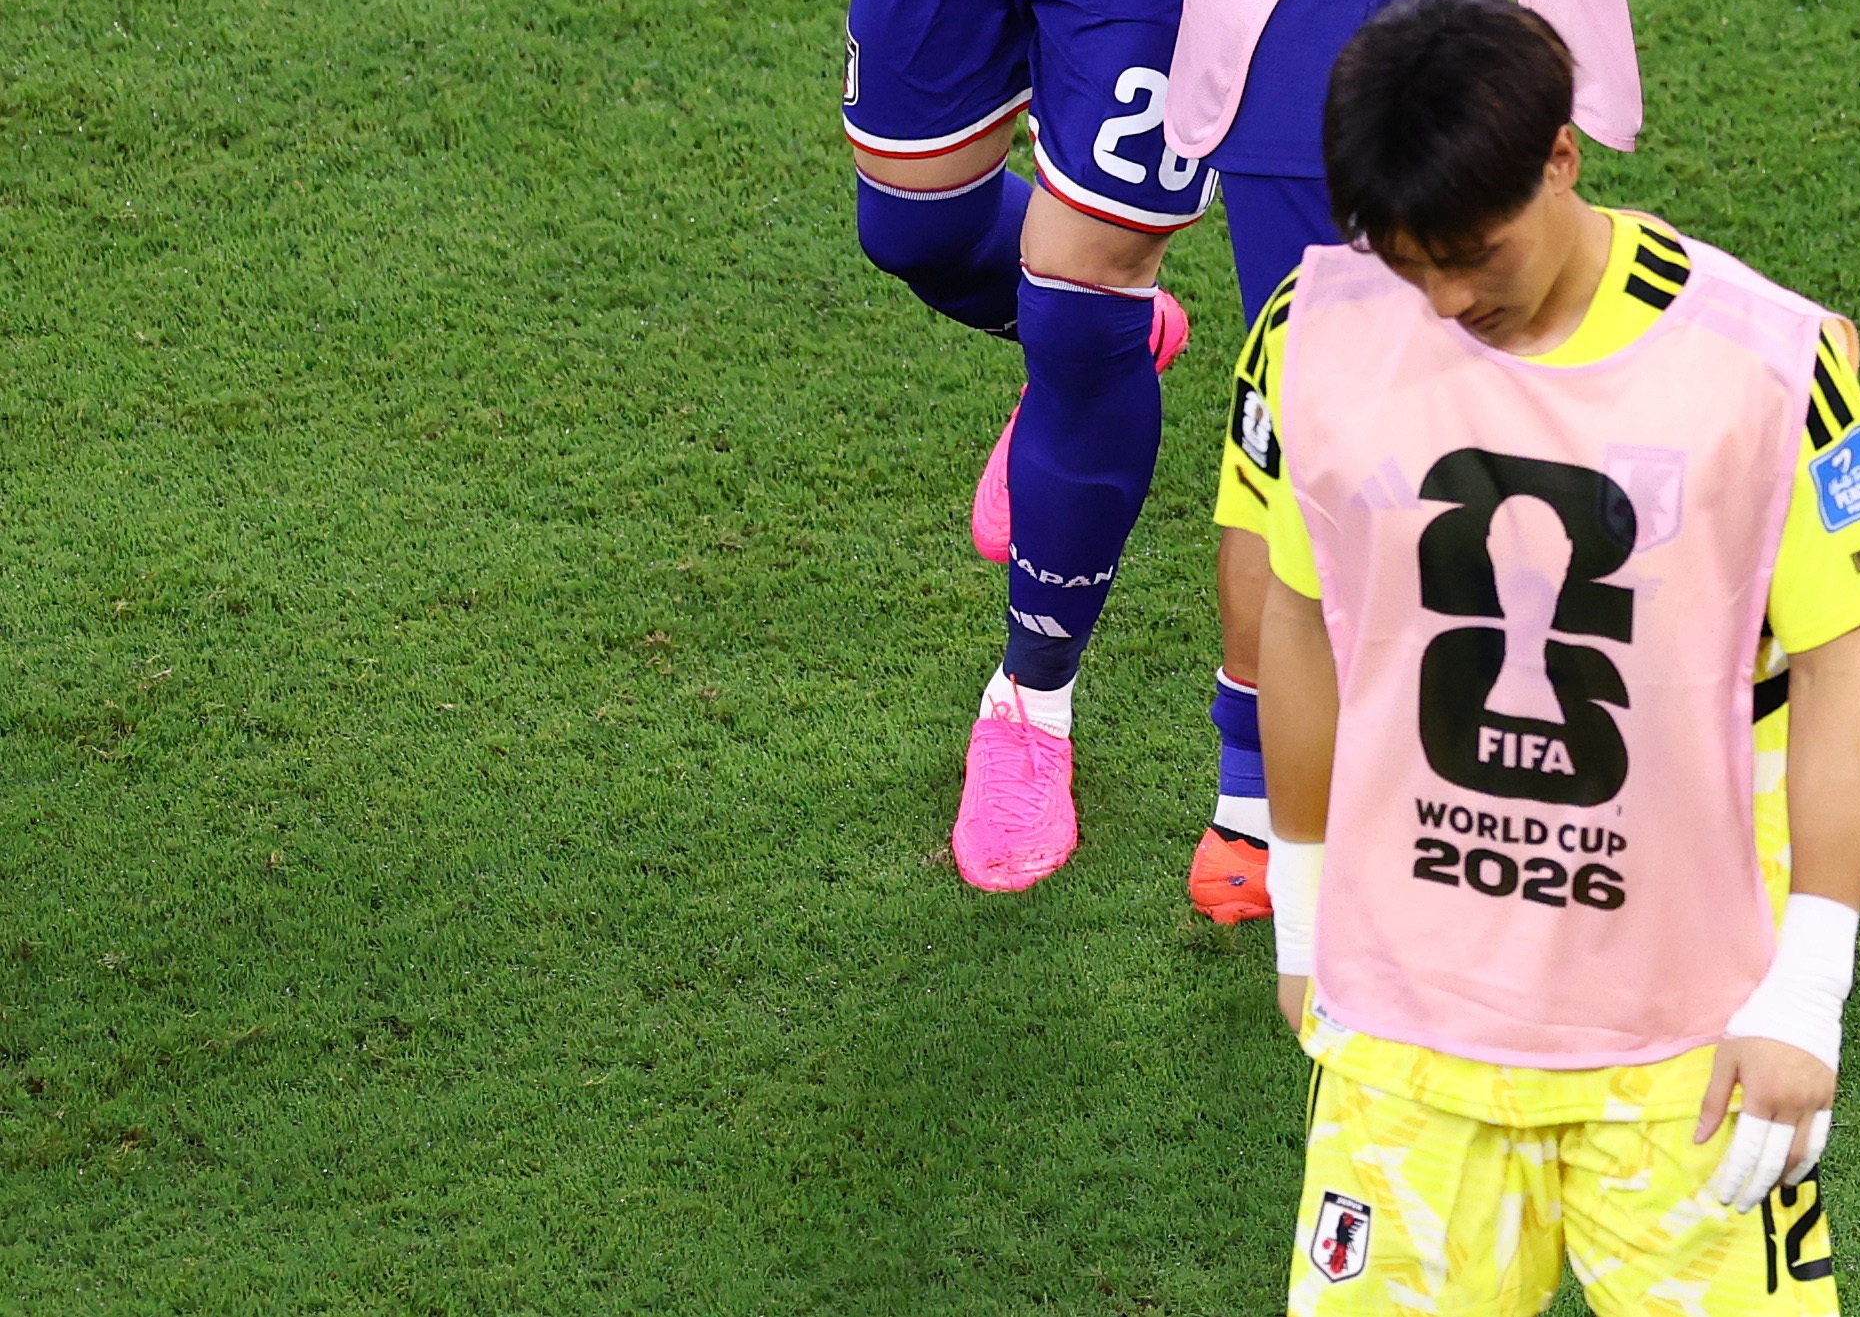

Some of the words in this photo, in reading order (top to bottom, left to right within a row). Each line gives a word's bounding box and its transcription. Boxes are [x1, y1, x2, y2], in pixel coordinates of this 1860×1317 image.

[1477, 725, 1576, 776] FIFA
[1415, 797, 1549, 845] WORLD
[1557, 823, 1628, 857] CUP
[1413, 837, 1626, 911] 2026
[1761, 1162, 1833, 1296] 12
